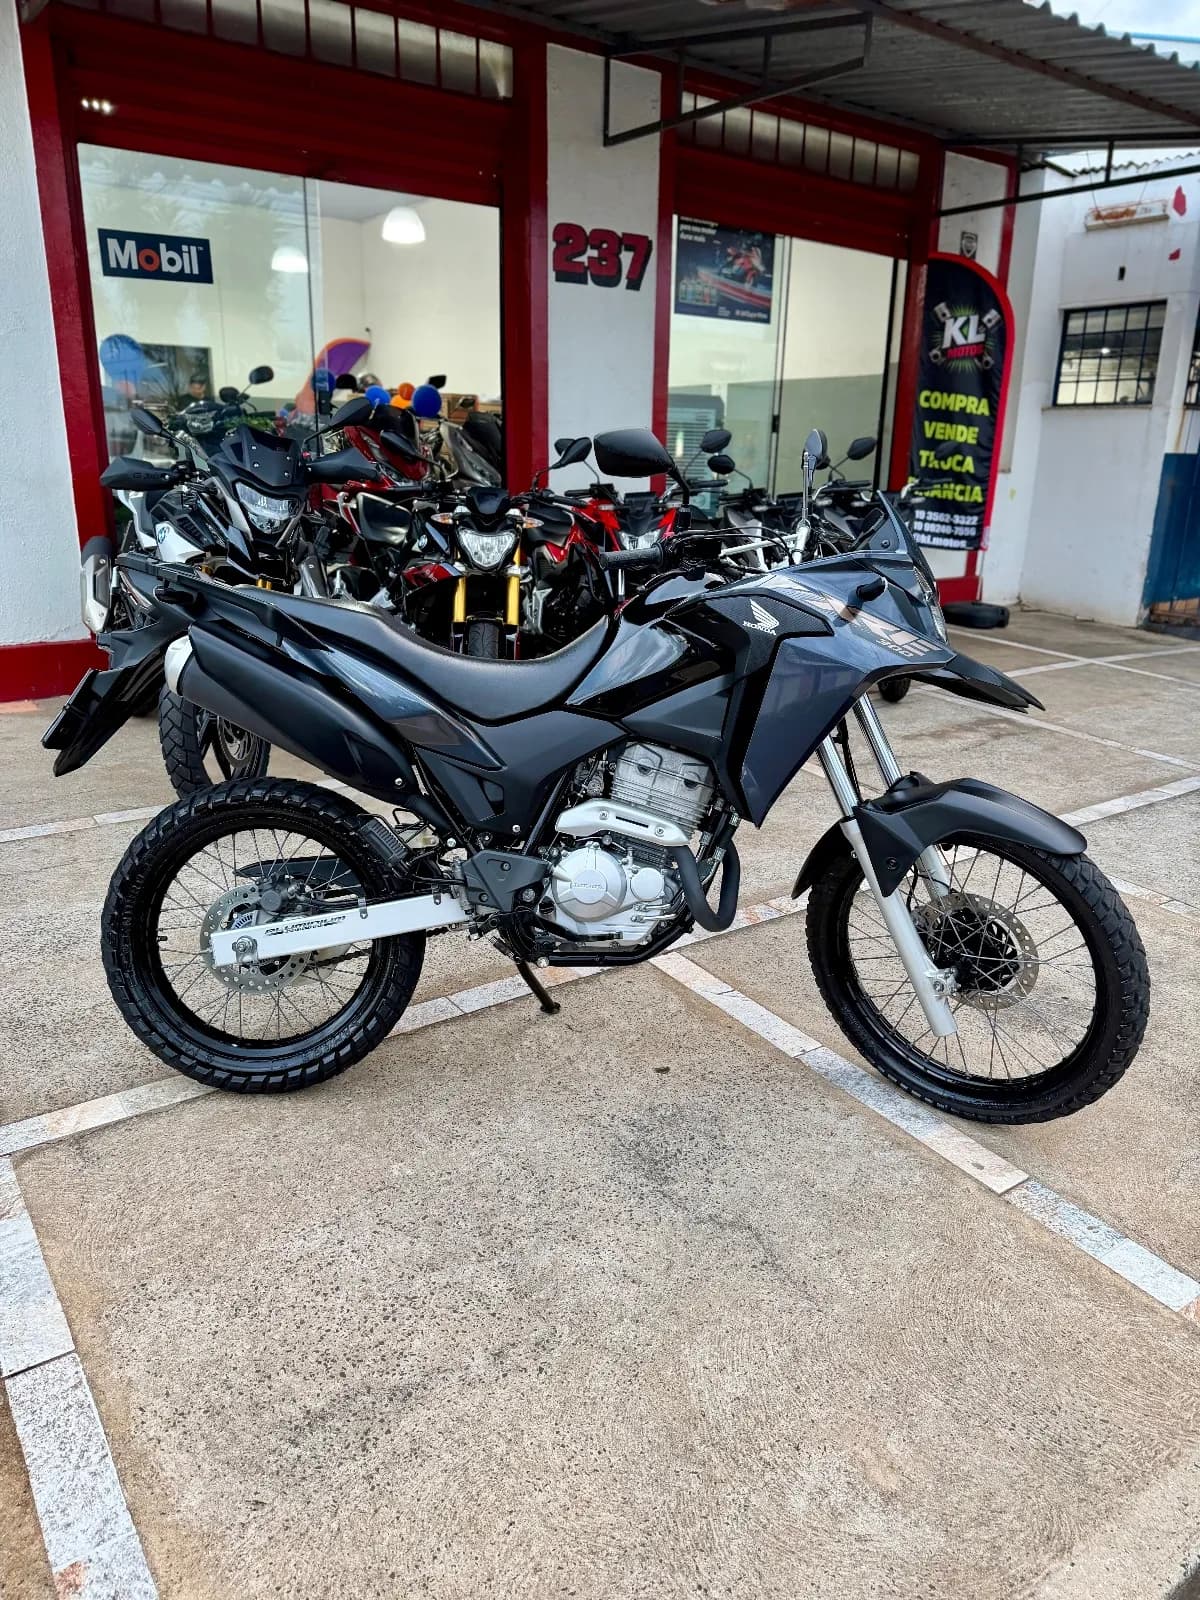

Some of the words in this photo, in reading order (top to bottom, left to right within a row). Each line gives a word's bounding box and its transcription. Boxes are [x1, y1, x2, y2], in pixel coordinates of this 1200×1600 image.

[106, 237, 200, 275] Mobil
[552, 222, 653, 291] 237
[942, 314, 986, 349] KL
[919, 389, 990, 416] COMPRA
[924, 420, 979, 445] VENDE
[742, 620, 777, 636] HONDA
[875, 637, 915, 658] 300
